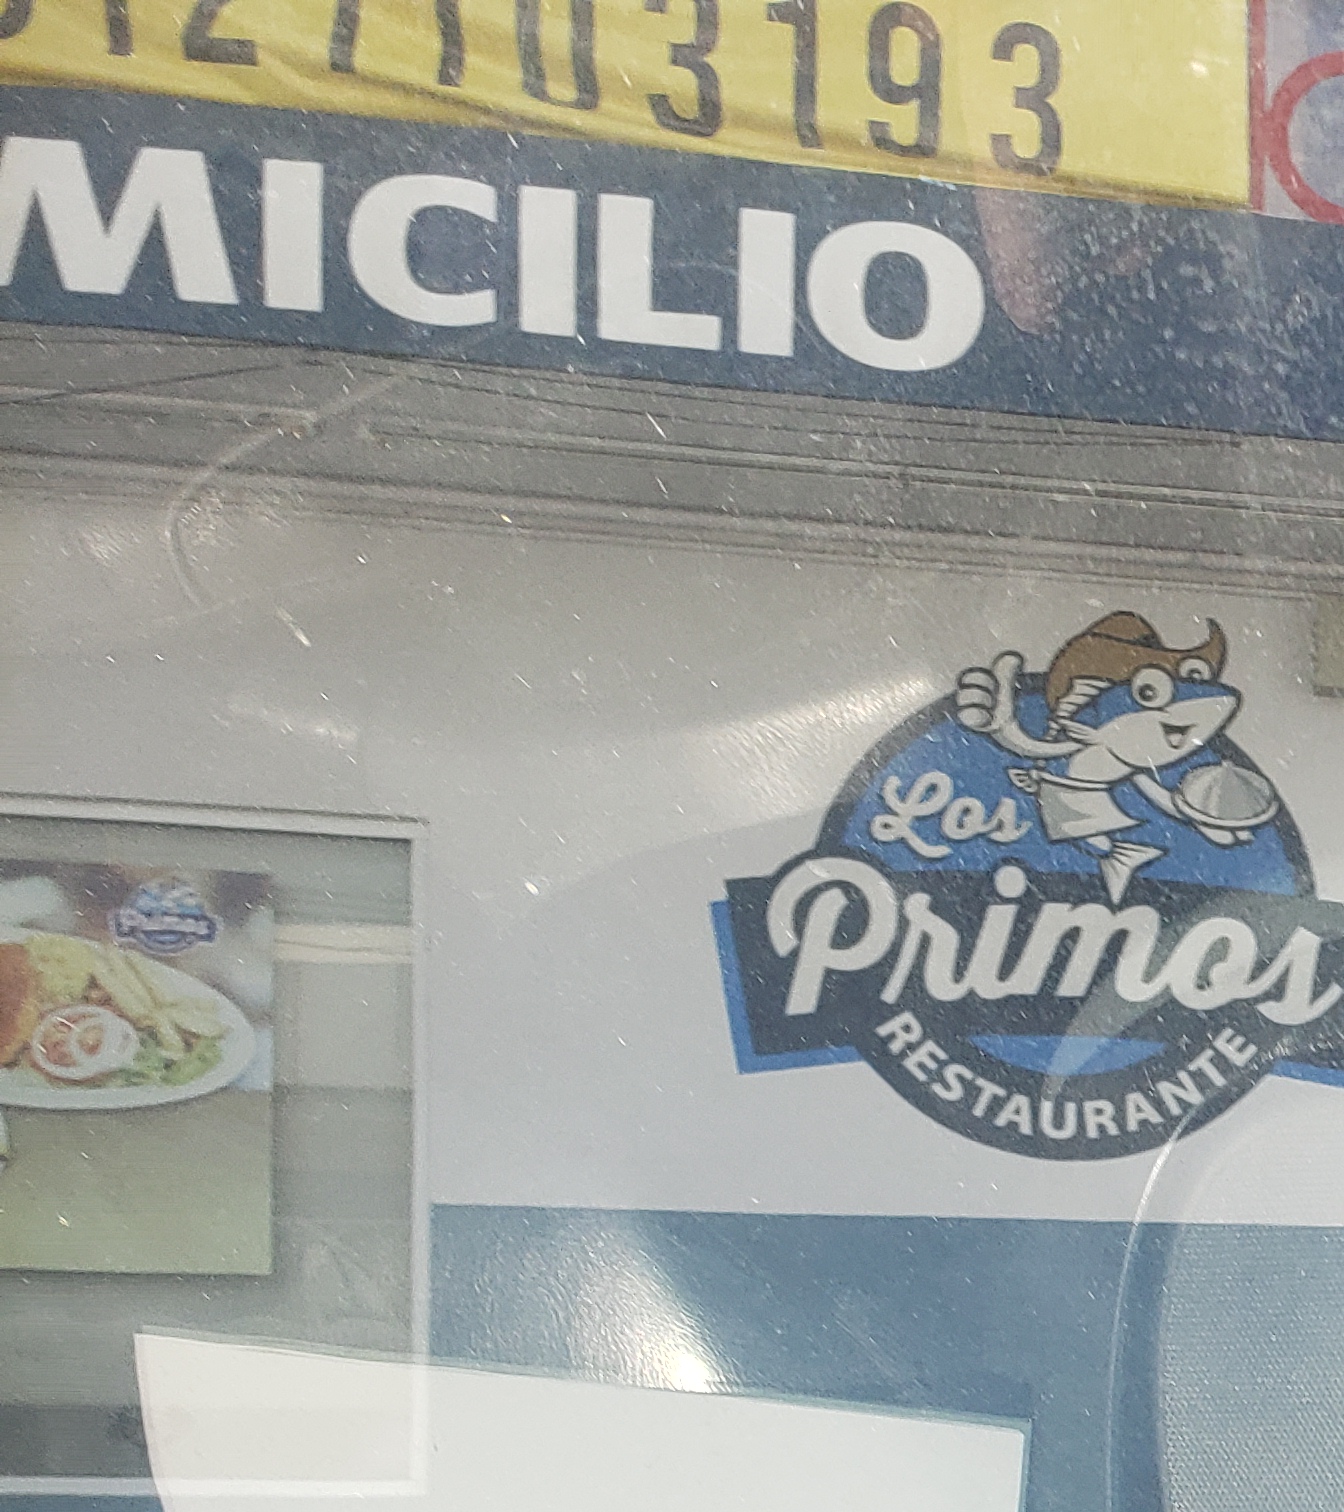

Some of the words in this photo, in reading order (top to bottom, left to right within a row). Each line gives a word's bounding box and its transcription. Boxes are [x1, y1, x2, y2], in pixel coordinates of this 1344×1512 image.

[0, 136, 986, 372] MICILIO
[869, 770, 1032, 859] Los
[766, 856, 1343, 1026] Primos
[874, 1011, 1258, 1140] RESTAURANTE
